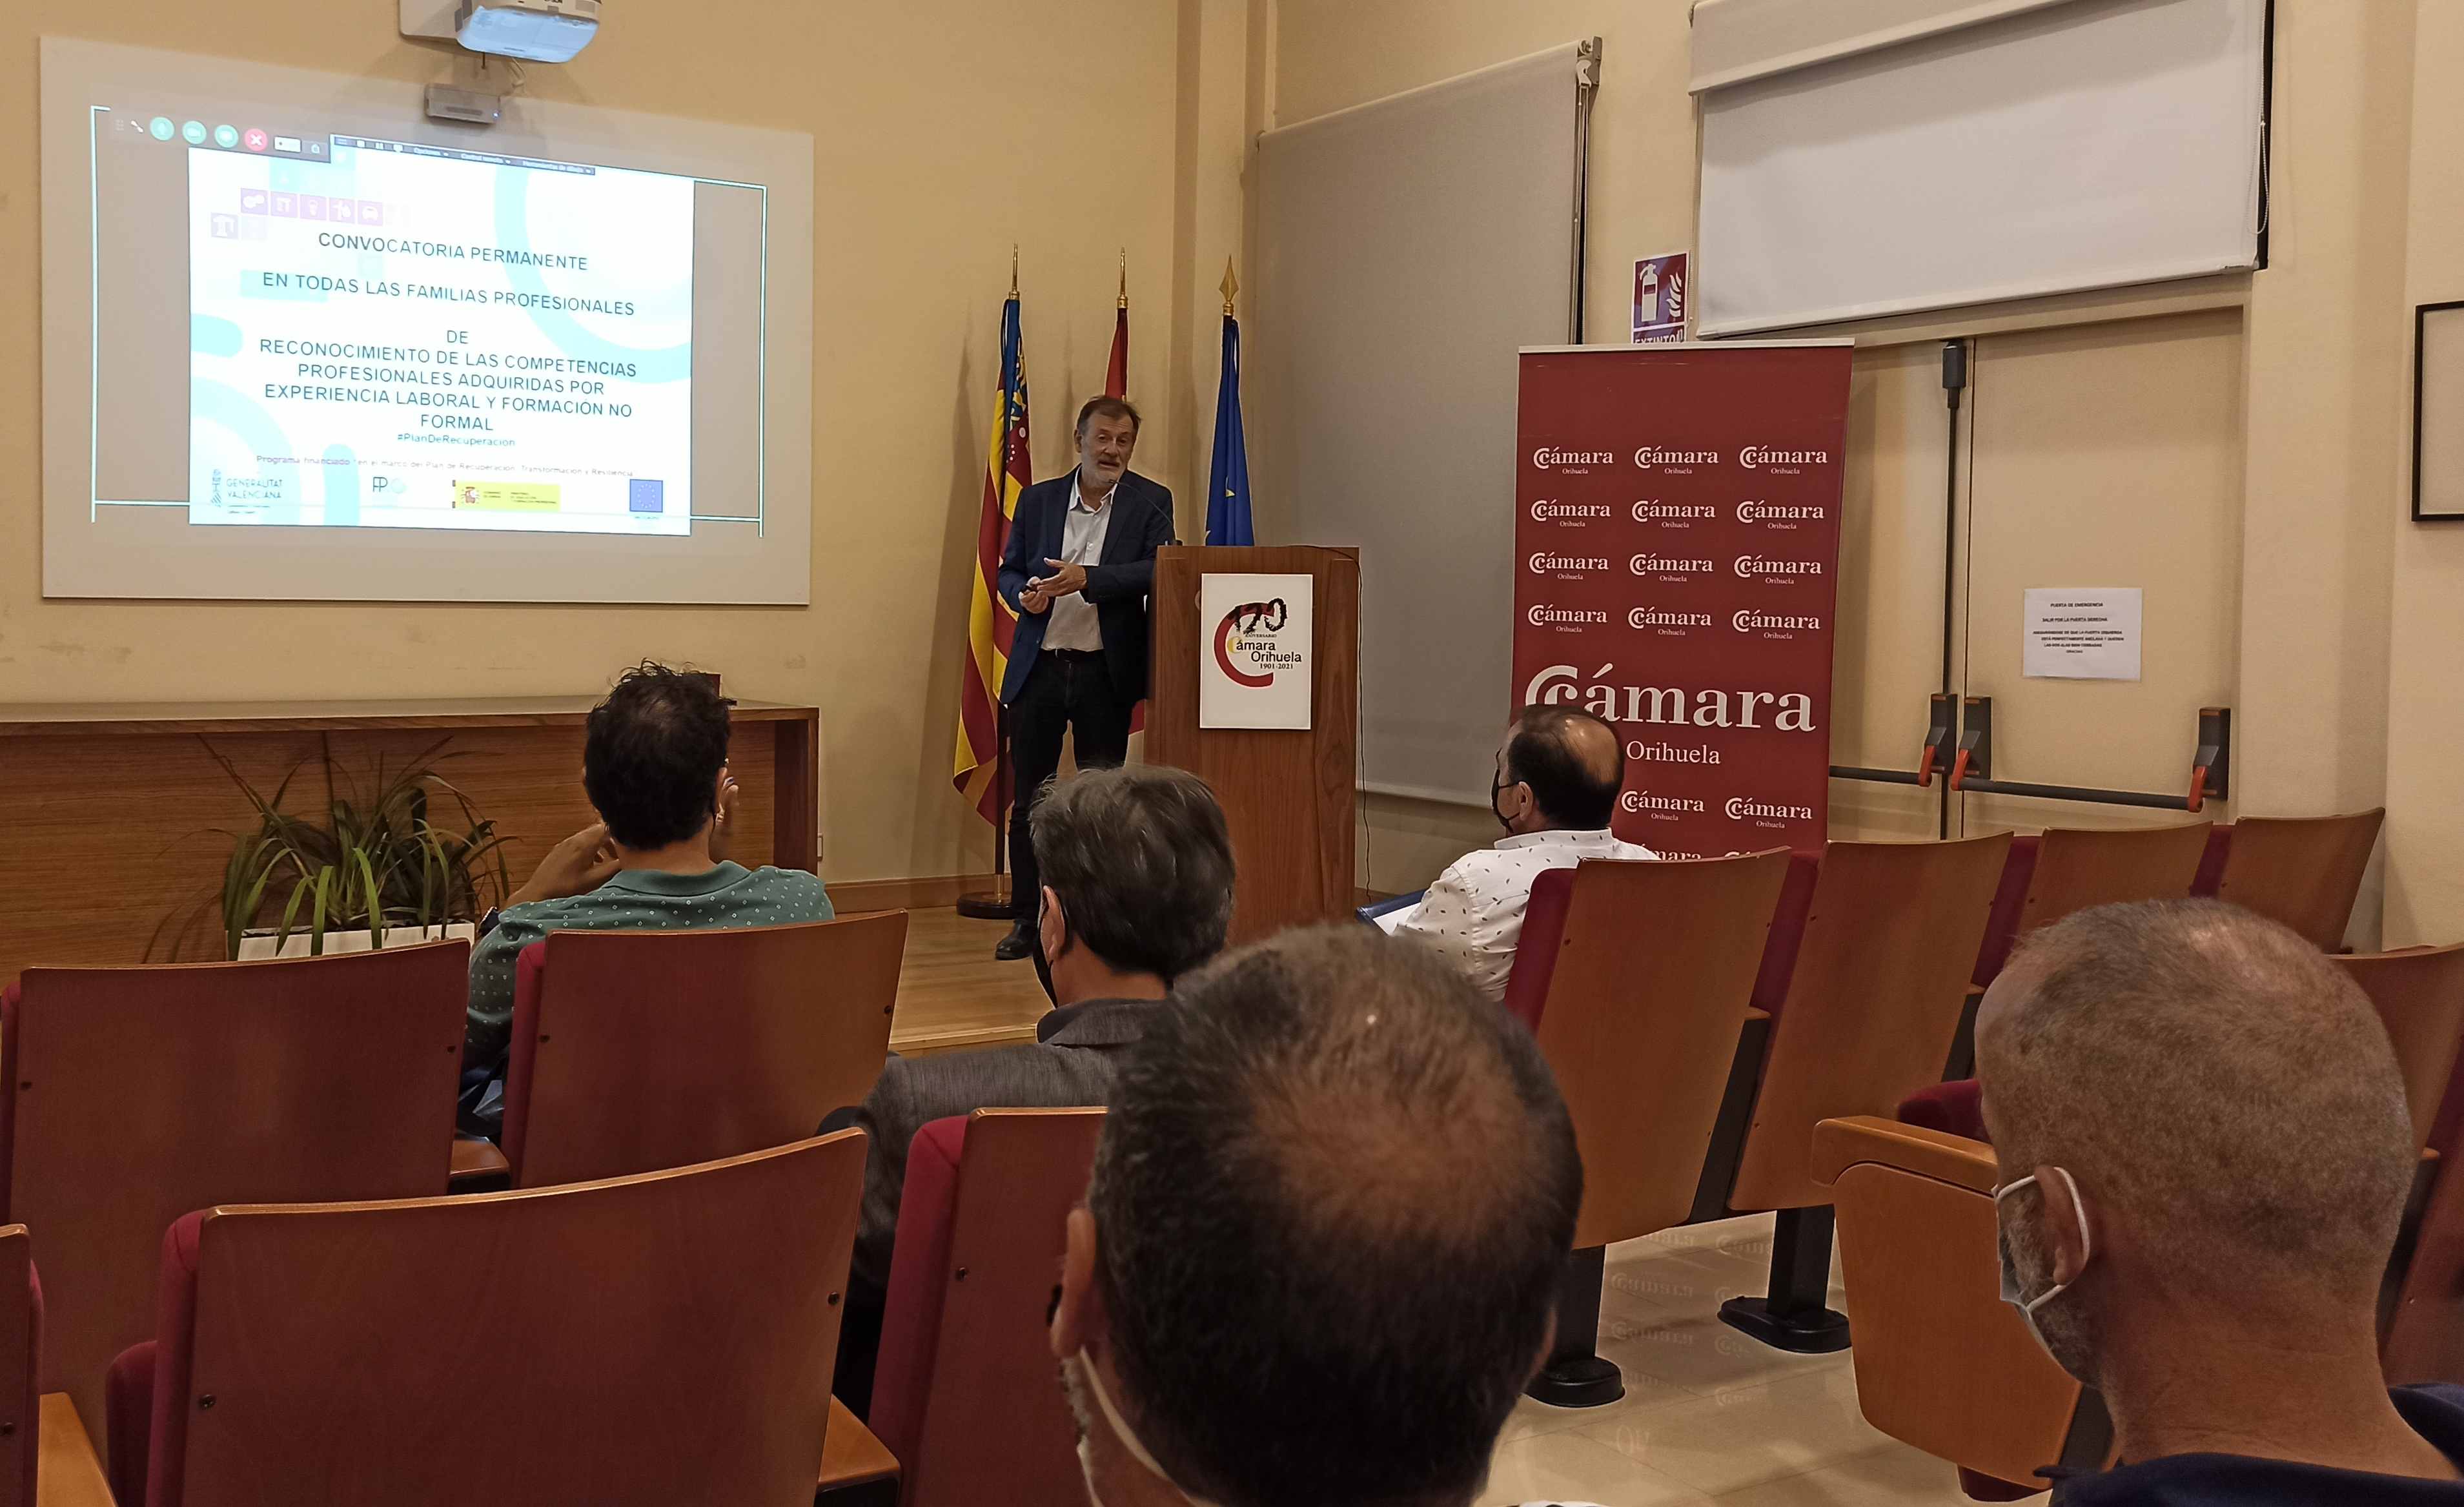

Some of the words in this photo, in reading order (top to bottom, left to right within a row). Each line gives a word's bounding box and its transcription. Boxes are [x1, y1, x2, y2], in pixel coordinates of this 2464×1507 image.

[319, 232, 465, 259] CONVOCATORIA
[471, 248, 589, 271] PERMANENTE
[263, 272, 288, 288] EN
[296, 274, 359, 294] TODAS
[366, 282, 400, 297] LAS
[407, 284, 487, 304] FAMILIAS
[494, 291, 635, 316] PROFESIONALES
[447, 330, 469, 345] DE
[260, 339, 431, 364] RECONOCIMIENTO
[436, 351, 459, 365] DE
[466, 353, 499, 367] LAS
[505, 355, 637, 378] COMPETENCIAS
[298, 364, 453, 386] PROFESIONALES
[458, 373, 565, 393] ADQUIRIDAS
[570, 381, 605, 395] POR
[265, 384, 390, 404] EXPERIENCIA
[396, 391, 480, 409] LABORAL
[486, 396, 496, 409] Y
[502, 397, 603, 416] FORMACIÓN
[609, 403, 633, 418] NO
[420, 414, 494, 431] FORMAL
[256, 455, 300, 465] Programa
[1250, 651, 1302, 662] Orihuela
[1626, 741, 1721, 764] Orihuela
[1651, 812, 1679, 821] Orihuela
[1755, 820, 1786, 829] Orihuela
